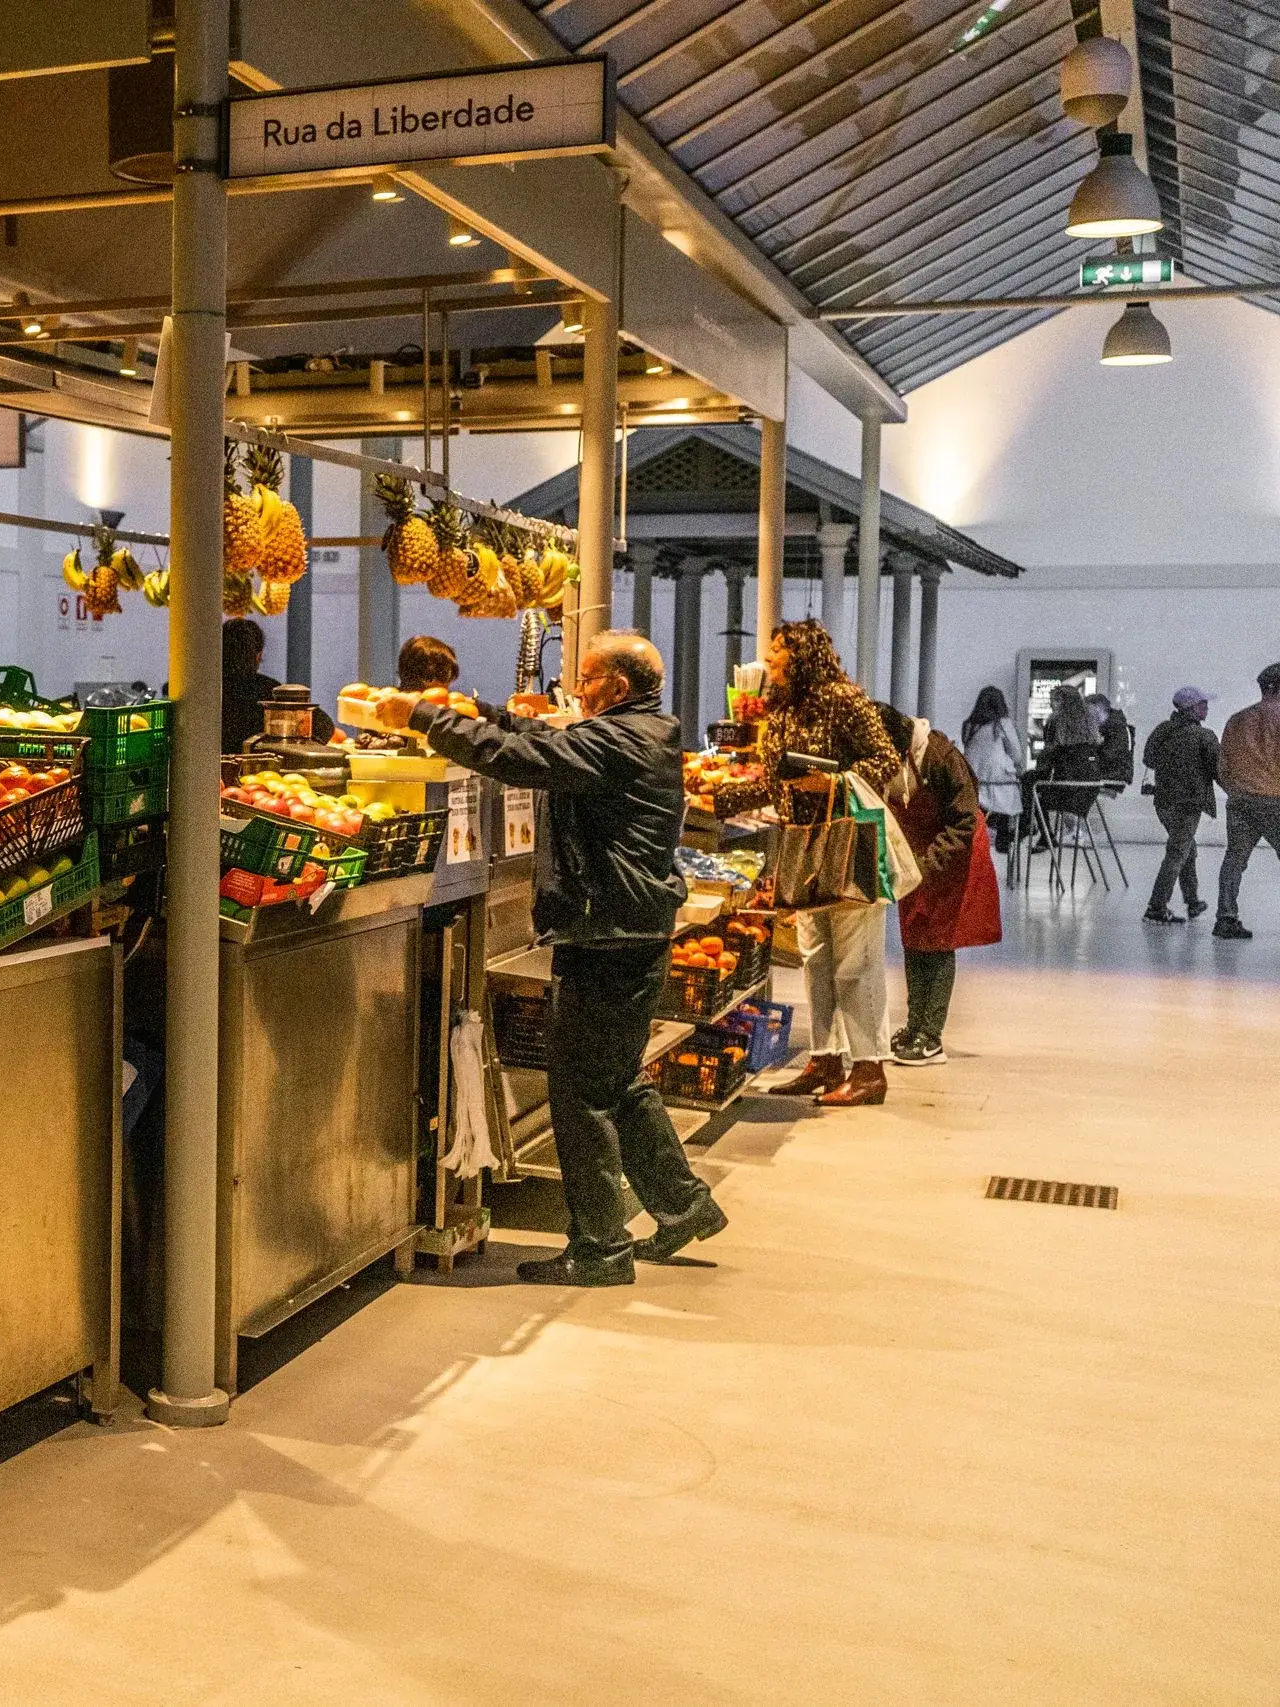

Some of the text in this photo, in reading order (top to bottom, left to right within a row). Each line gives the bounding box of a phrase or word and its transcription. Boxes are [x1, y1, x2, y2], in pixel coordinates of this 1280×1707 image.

[263, 94, 535, 148] Rua da Liberdade
